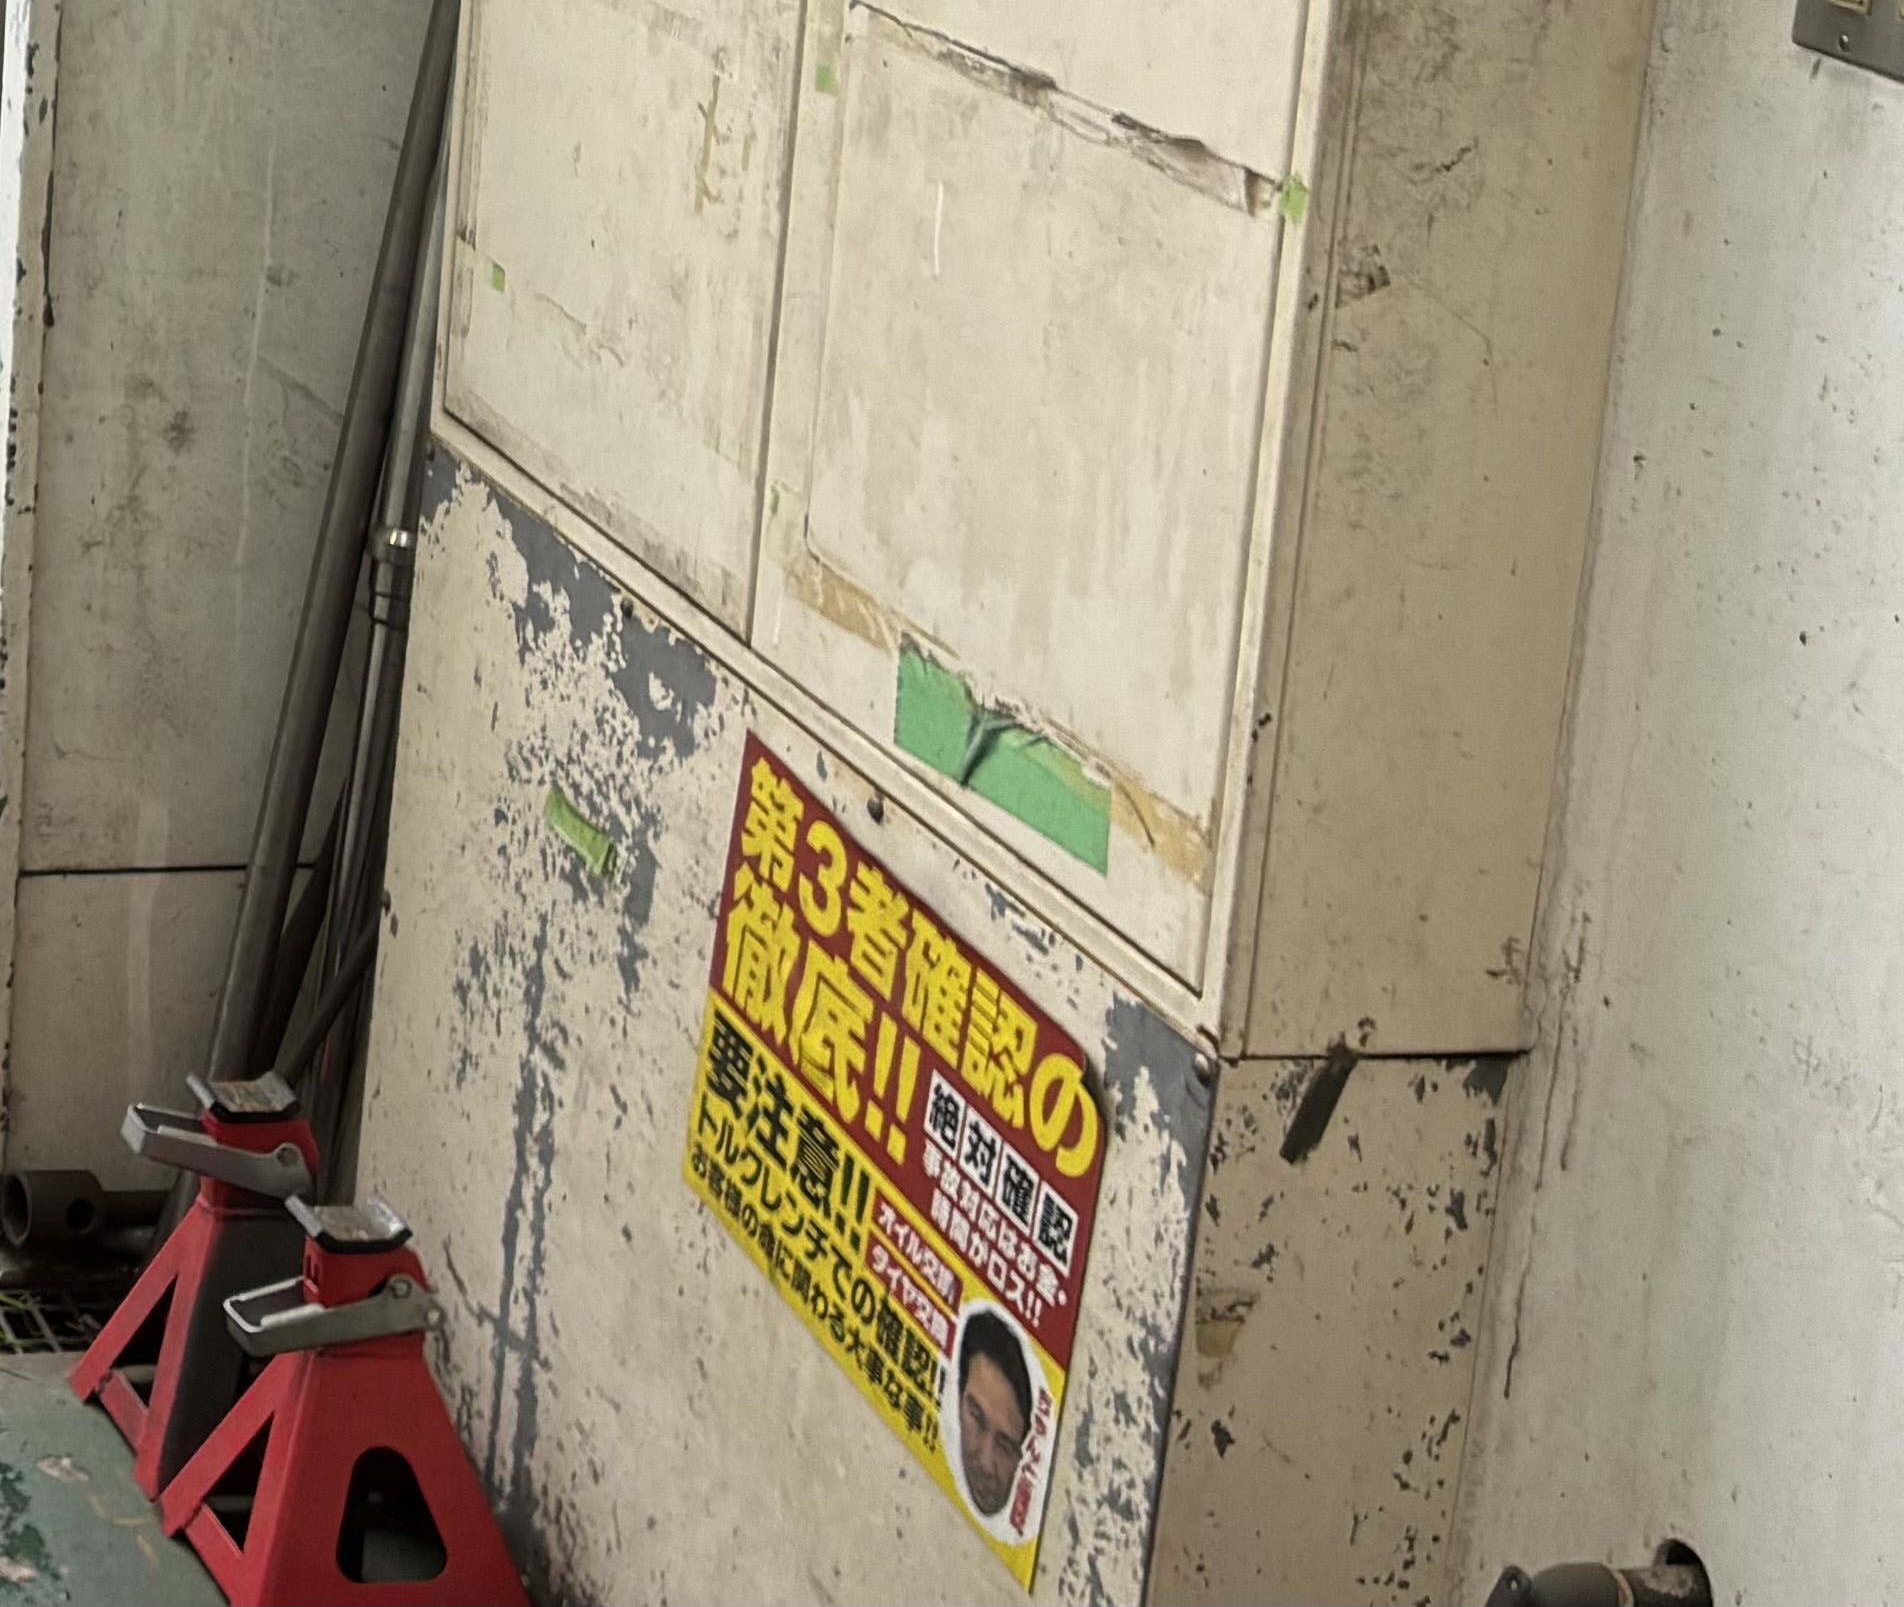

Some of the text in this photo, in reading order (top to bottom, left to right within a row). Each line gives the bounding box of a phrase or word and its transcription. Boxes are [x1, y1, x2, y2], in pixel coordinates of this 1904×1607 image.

[722, 862, 920, 1165] 徹底!!
[741, 756, 1099, 1177] 第3者確認の
[706, 1007, 870, 1253] 要注意!!
[929, 1082, 1073, 1269] 絶対確認
